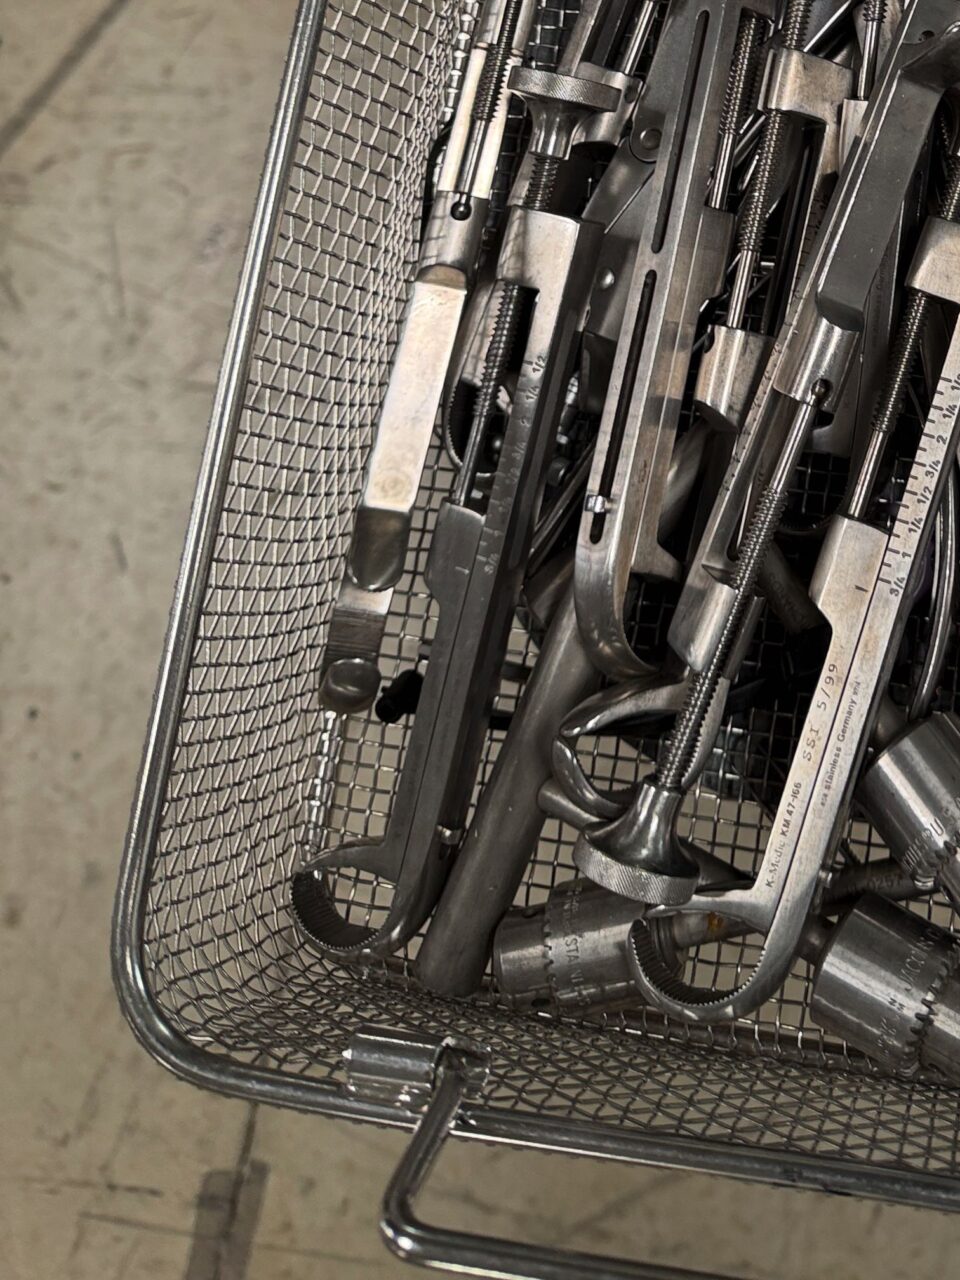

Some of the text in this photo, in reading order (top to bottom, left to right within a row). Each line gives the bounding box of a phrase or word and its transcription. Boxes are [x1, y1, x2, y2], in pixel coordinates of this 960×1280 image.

[941, 402, 959, 423] 1/4
[935, 434, 948, 448] 2
[924, 458, 942, 480] 3/4
[916, 484, 934, 506] 1/2
[907, 515, 924, 536] 1/4
[900, 550, 912, 560] 1
[888, 576, 907, 598] 3/4
[781, 818, 793, 838] KM
[802, 724, 821, 763] SSI
[816, 662, 839, 712] 5/99
[823, 744, 843, 792] stainless
[836, 698, 858, 744] Germany
